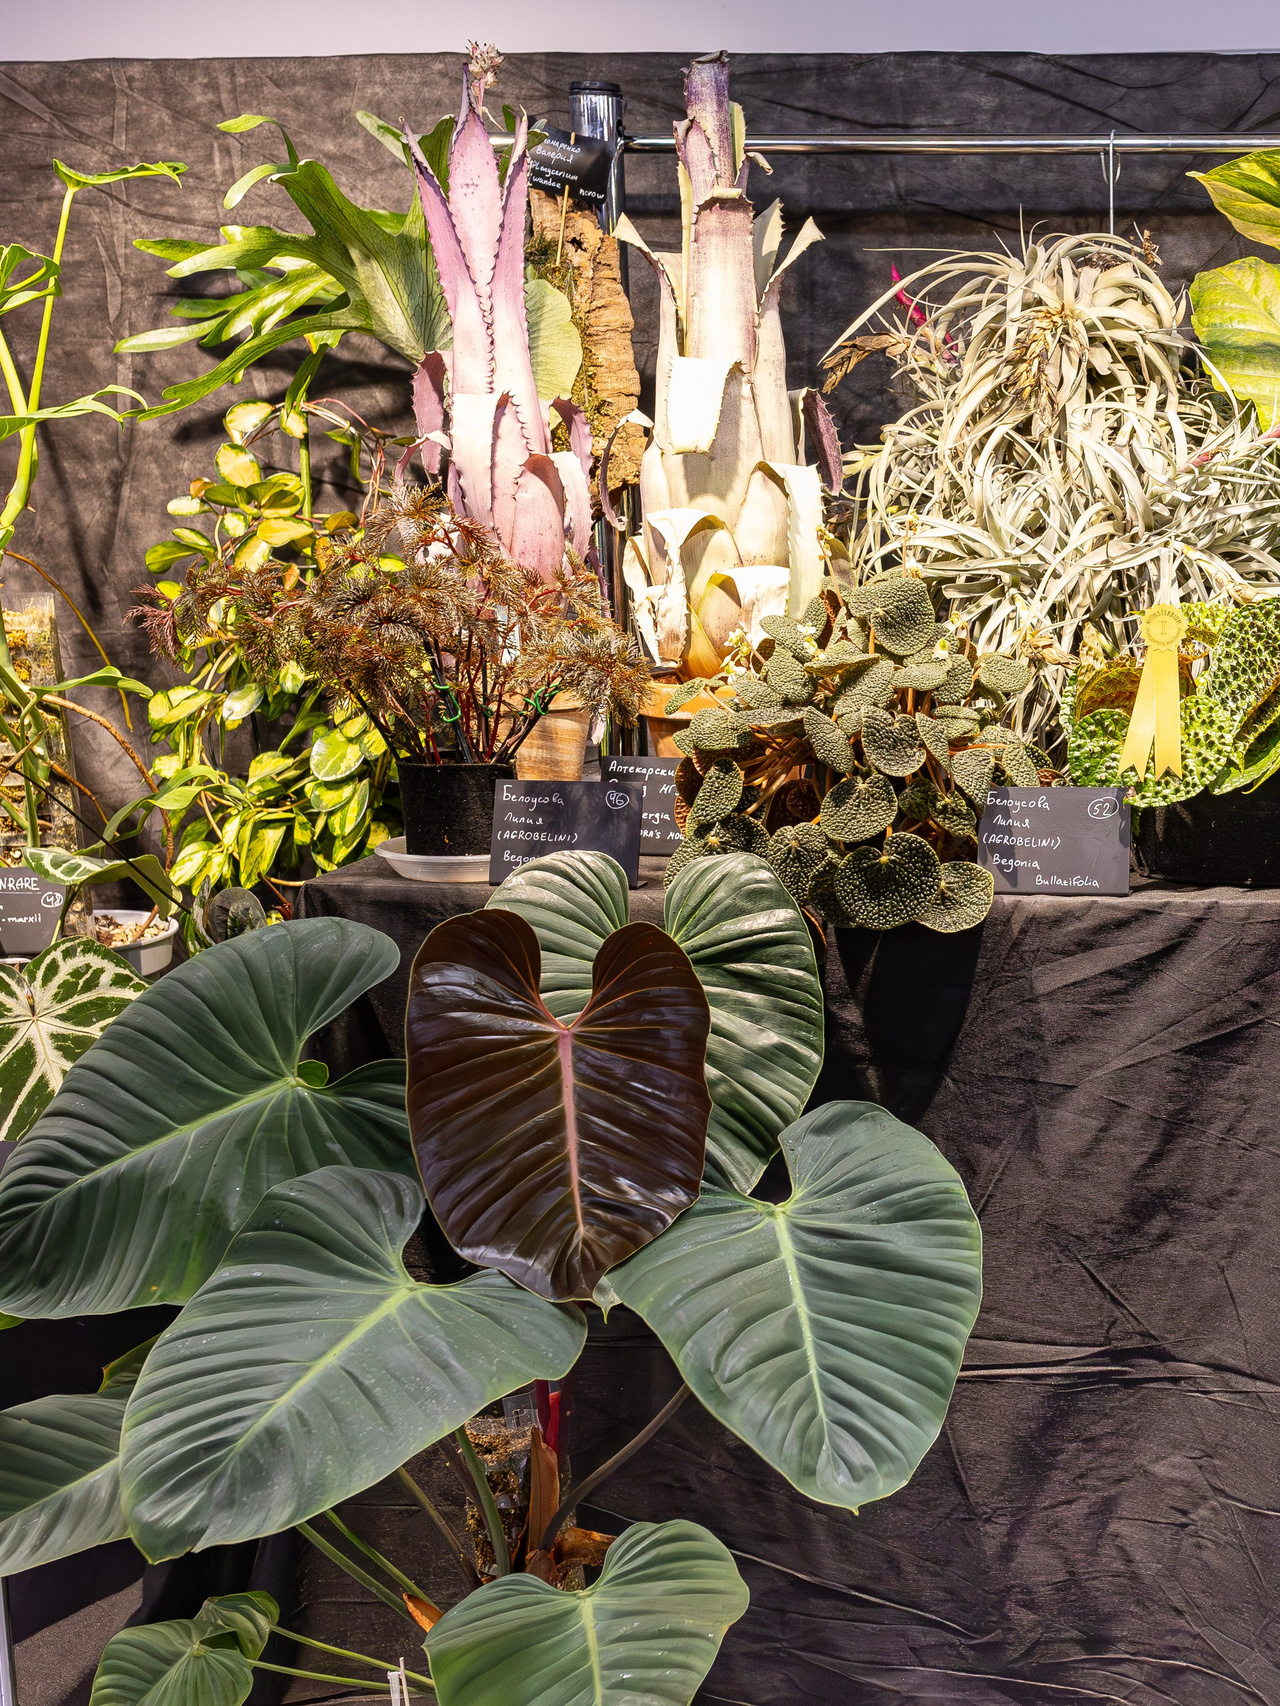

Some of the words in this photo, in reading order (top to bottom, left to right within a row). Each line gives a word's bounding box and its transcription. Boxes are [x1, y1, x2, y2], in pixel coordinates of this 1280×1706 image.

[608, 760, 677, 781] Аптекарски
[502, 784, 565, 811] Белоусова
[986, 791, 1050, 813] Белоусова
[504, 812, 544, 825] Лилия
[993, 814, 1031, 828] Лилия
[497, 830, 579, 844] (AGROBELINI)
[982, 832, 1061, 850] (AGROBELINI)
[992, 853, 1041, 873] Begonia
